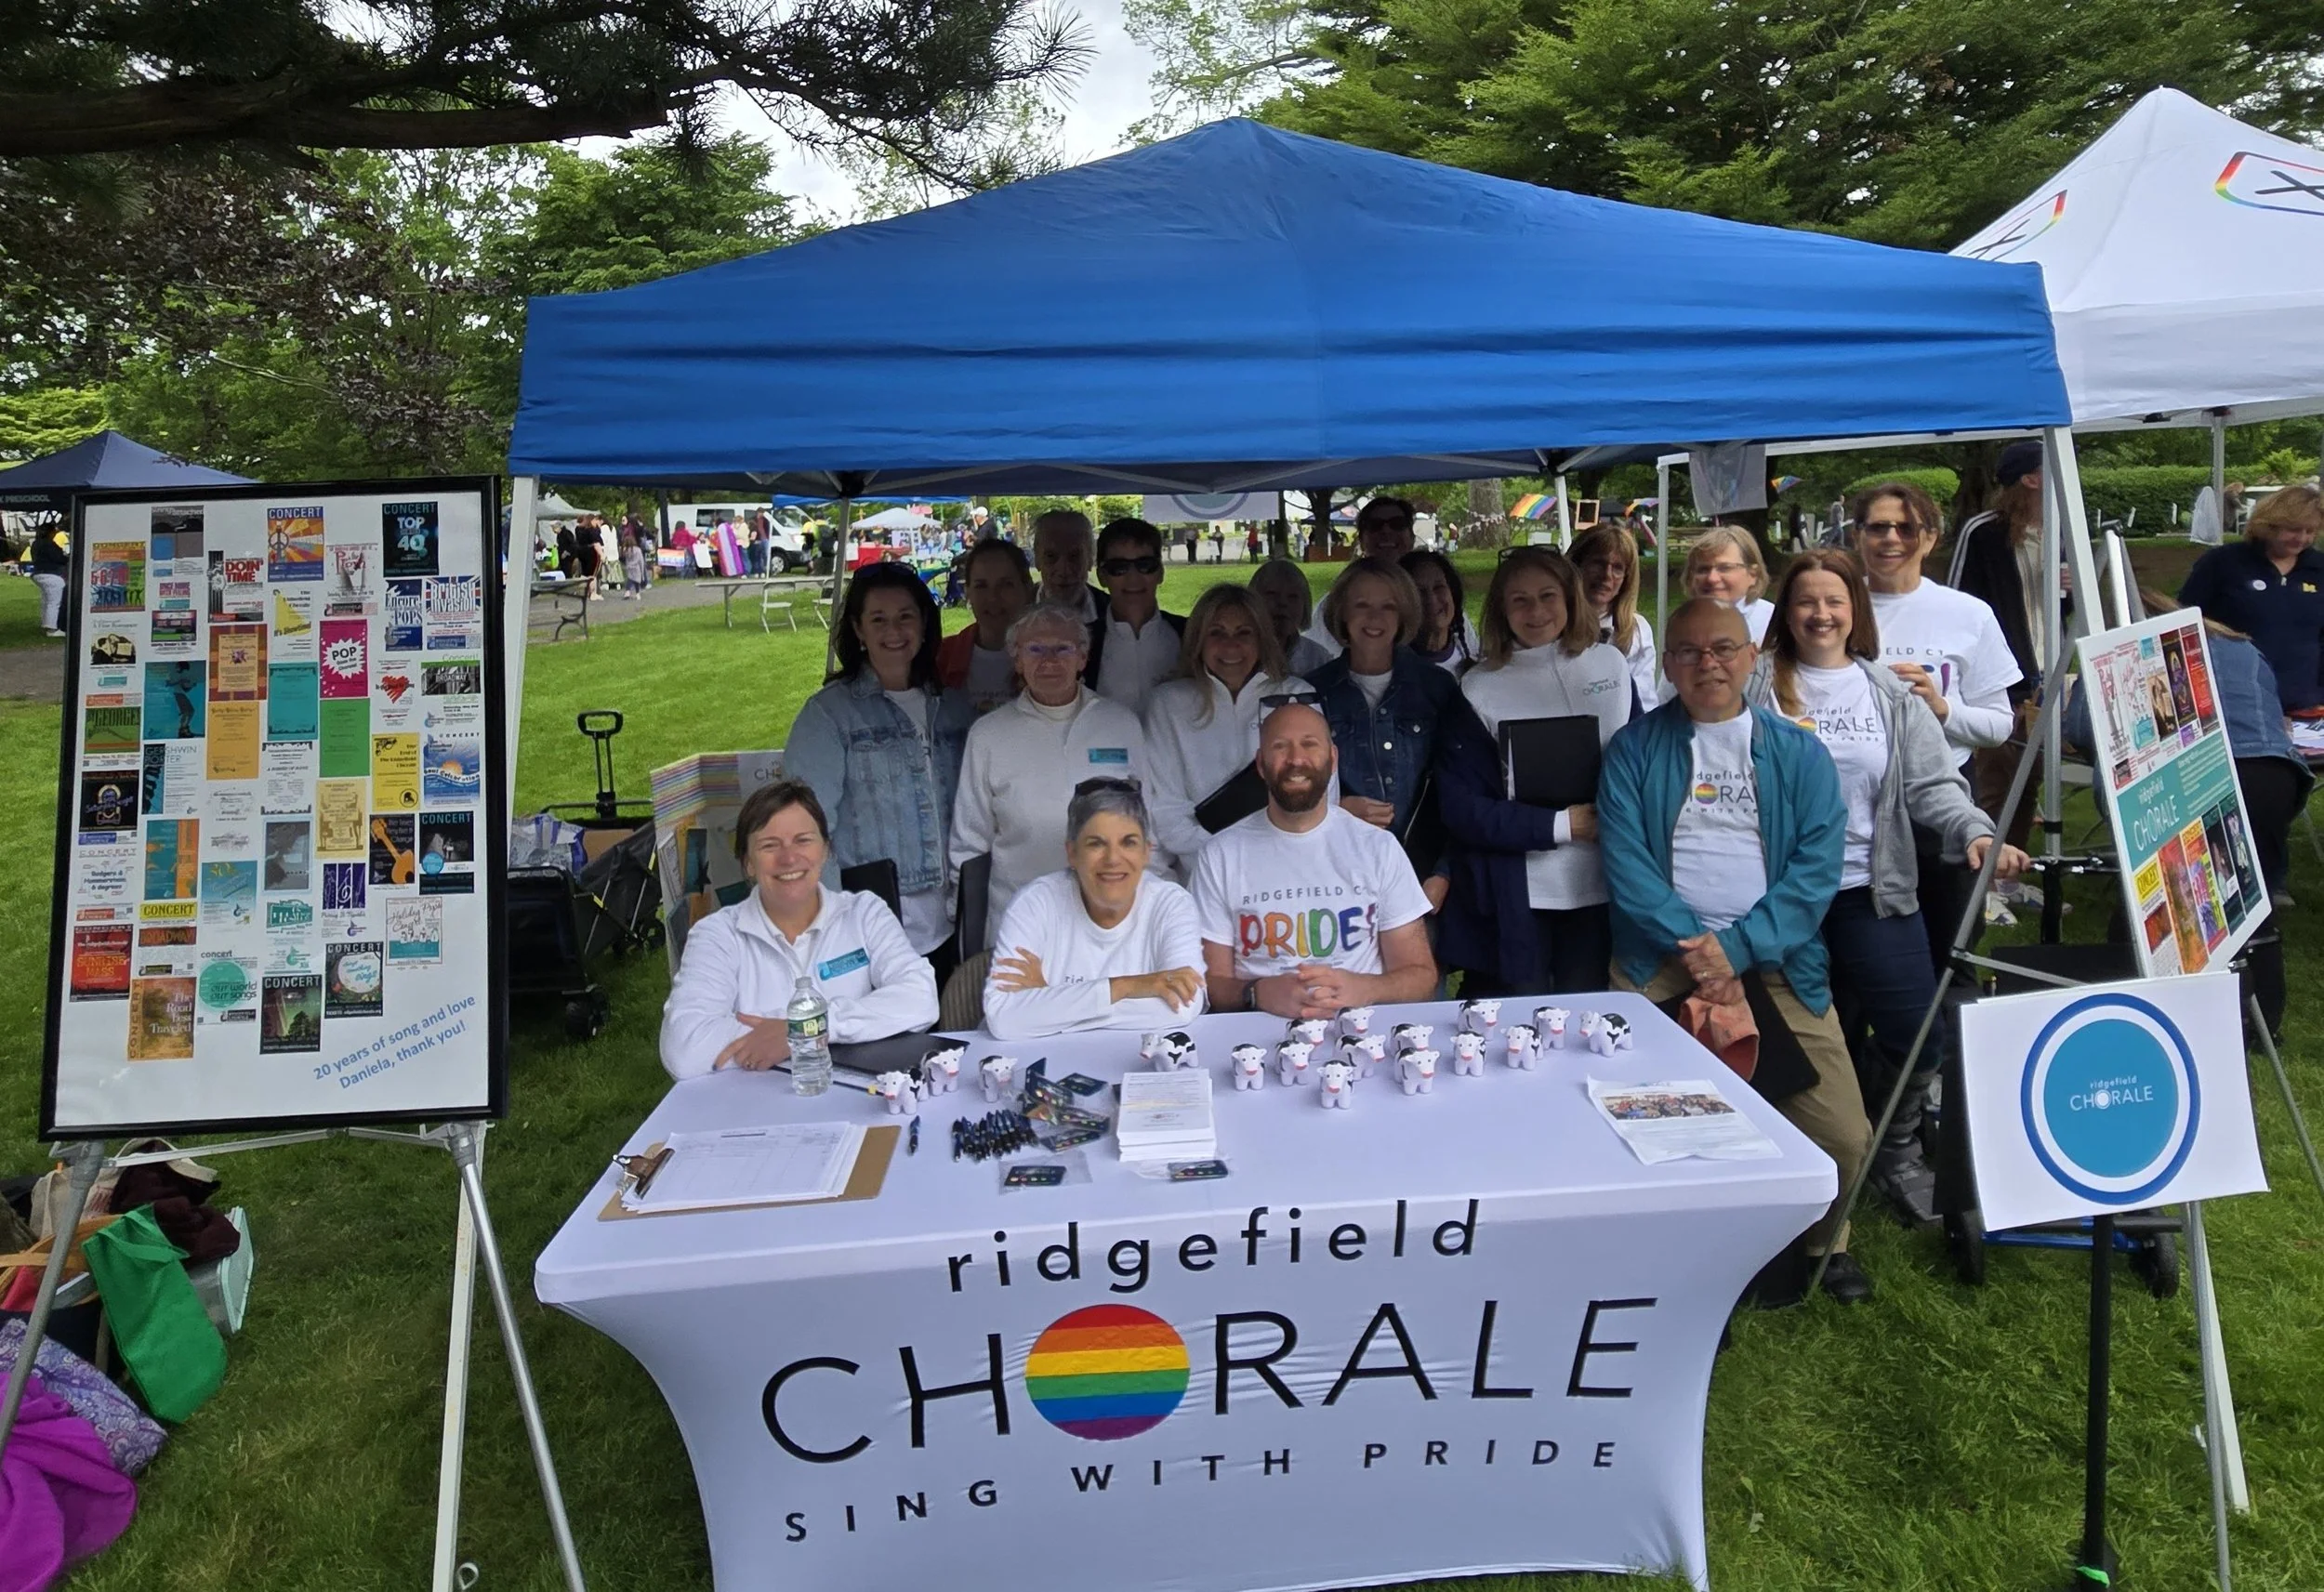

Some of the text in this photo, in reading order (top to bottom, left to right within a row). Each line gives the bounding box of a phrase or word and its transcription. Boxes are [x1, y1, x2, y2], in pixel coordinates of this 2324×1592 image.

[269, 507, 322, 519] CONCERT
[383, 503, 436, 515] CONCERT
[397, 517, 425, 529] TOP
[397, 533, 427, 551] 40
[225, 558, 264, 572] DOIN'
[225, 572, 256, 583] TIME
[394, 609, 423, 625] POPS
[332, 646, 357, 661] POP
[435, 673, 467, 682] BROADWAY
[144, 745, 198, 756] GERSHWIN
[422, 813, 471, 824] CONCERT
[2133, 795, 2180, 851] CHORALE
[1243, 886, 1343, 905] RIDGEFIELD
[144, 904, 194, 916] CONCERT
[201, 949, 232, 958] concert
[327, 943, 381, 954] CONCERT
[230, 980, 257, 991] world
[264, 977, 320, 988] CONCERT
[175, 992, 191, 1003] The
[230, 991, 257, 1000] songs
[166, 1003, 191, 1013] Road
[149, 1022, 191, 1034] Traveled
[313, 995, 476, 1080] 20 years of song and love
[339, 1020, 466, 1089] Daniela, thank you!
[2090, 1075, 2137, 1089] ridgefield
[2069, 1085, 2154, 1111] CHORALE
[948, 1198, 1479, 1295] ridgefield
[761, 1297, 1658, 1465] CHORALE
[786, 1440, 1616, 1543] SING WITH PRIDE
